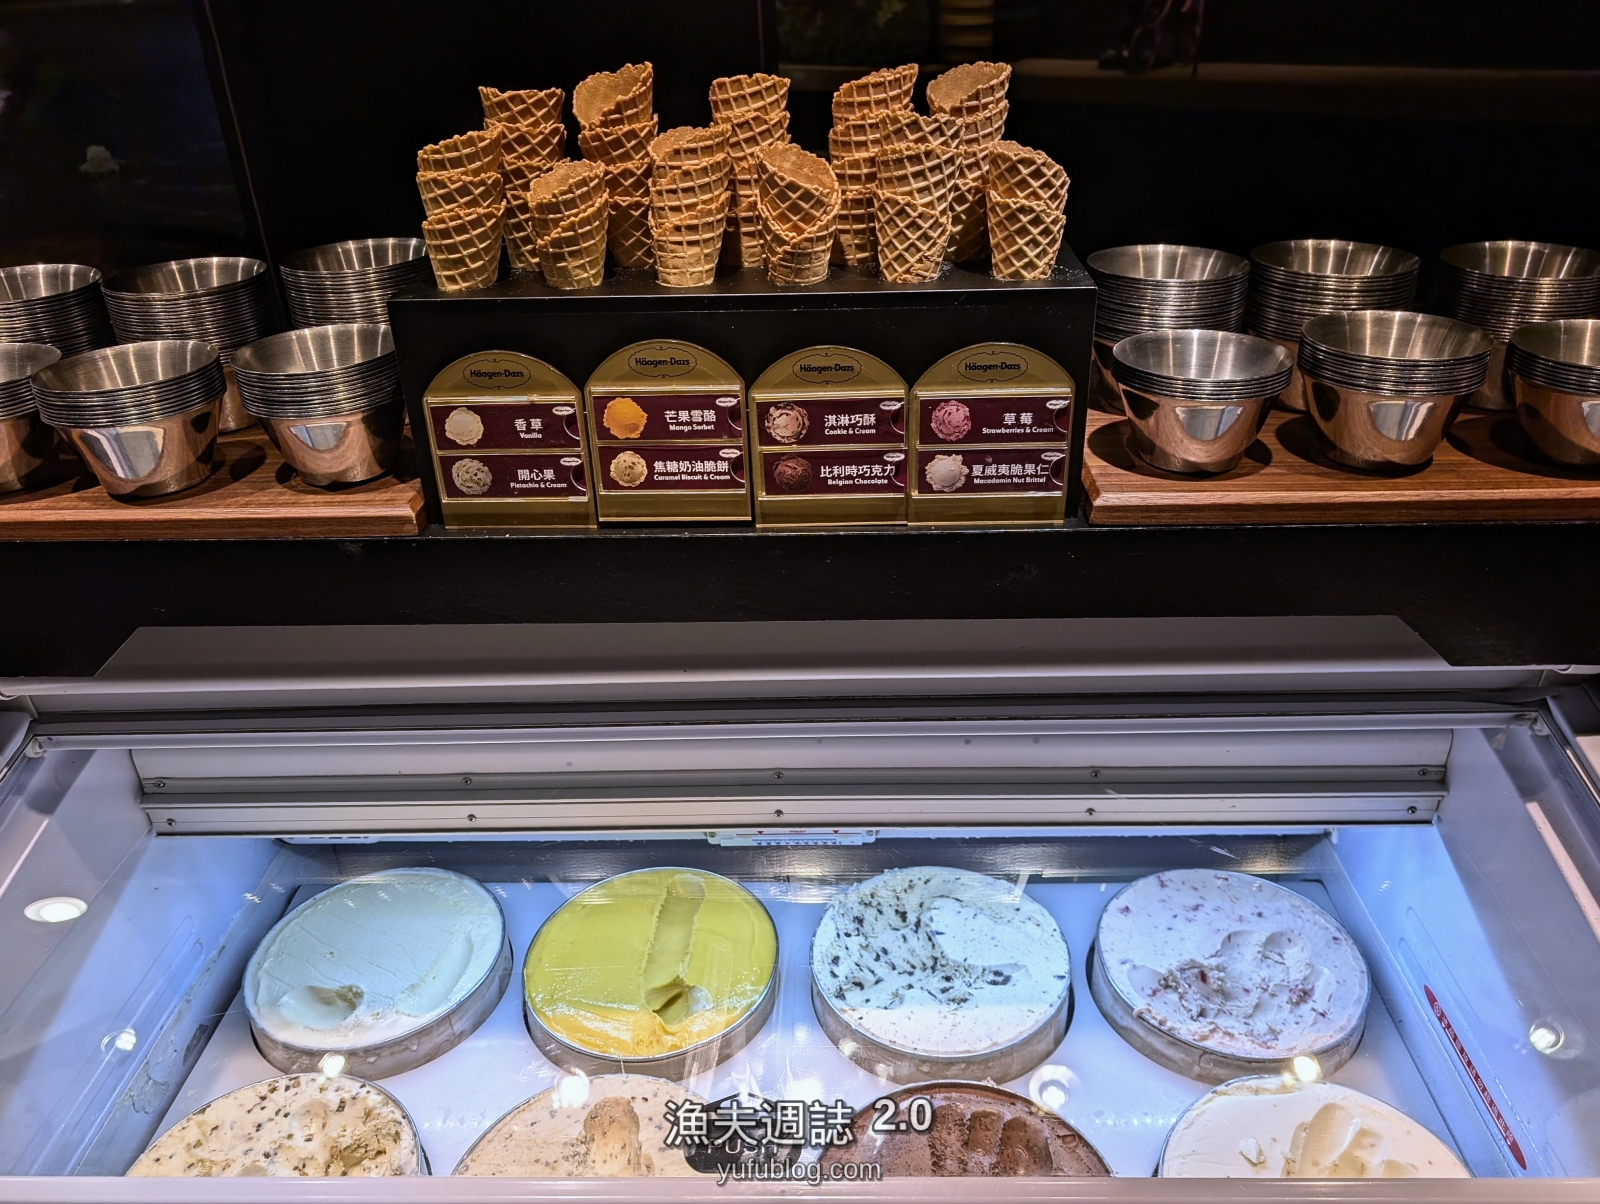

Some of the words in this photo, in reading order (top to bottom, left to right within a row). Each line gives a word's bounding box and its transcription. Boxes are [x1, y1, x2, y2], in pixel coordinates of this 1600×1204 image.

[635, 357, 690, 368] Häagen-Dazs
[964, 362, 1021, 373] Häagen-Dazs
[470, 369, 524, 380] Häagen-Dazs
[799, 364, 855, 374] Häagen-Dazs
[663, 409, 717, 423] 芒果雪酪
[823, 413, 877, 427] 淇淋巧酥
[1002, 412, 1034, 425] 草莓
[513, 417, 544, 431] 香草
[669, 424, 692, 432] Mango
[693, 423, 715, 431] Sorbet
[519, 431, 543, 439] Vanilla
[854, 427, 876, 435] Cream
[653, 460, 729, 473] 焦糖奶油脆餅
[819, 464, 896, 478] 比利時巧克力
[971, 463, 1049, 476] 夏威夷脆果仁
[517, 468, 556, 481] 開心果
[681, 473, 702, 481] Biscuit
[1012, 476, 1025, 484] Nut
[510, 481, 539, 489] Pistachio
[827, 478, 853, 486] Belgian
